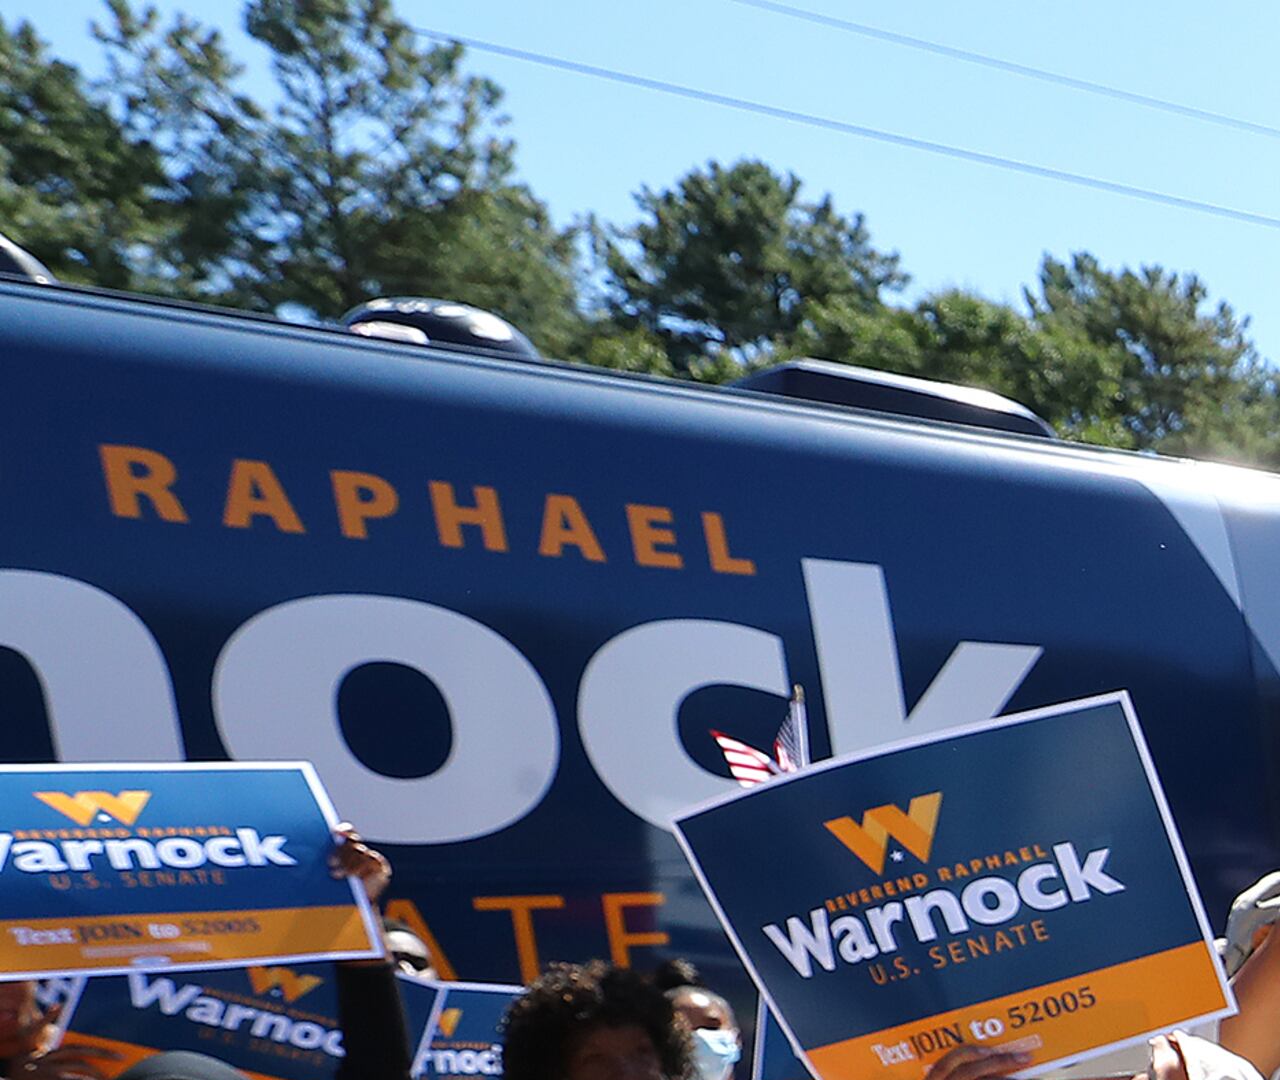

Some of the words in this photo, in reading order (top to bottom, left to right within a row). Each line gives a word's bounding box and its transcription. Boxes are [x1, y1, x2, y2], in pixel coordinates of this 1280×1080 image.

[100, 444, 756, 576] RAPHAEL
[0, 828, 297, 874] arnock
[824, 873, 929, 914] REVEREND
[937, 844, 1048, 882] RAPHAEL
[147, 921, 182, 940] to
[762, 842, 1126, 979] Warnock
[868, 958, 922, 987] U.S.
[928, 918, 1051, 970] SENATE
[128, 970, 346, 1058] Warnoc
[871, 1040, 914, 1067] Text
[910, 1023, 964, 1060] JOIN
[968, 1018, 1004, 1041] to
[1007, 986, 1097, 1030] 52005
